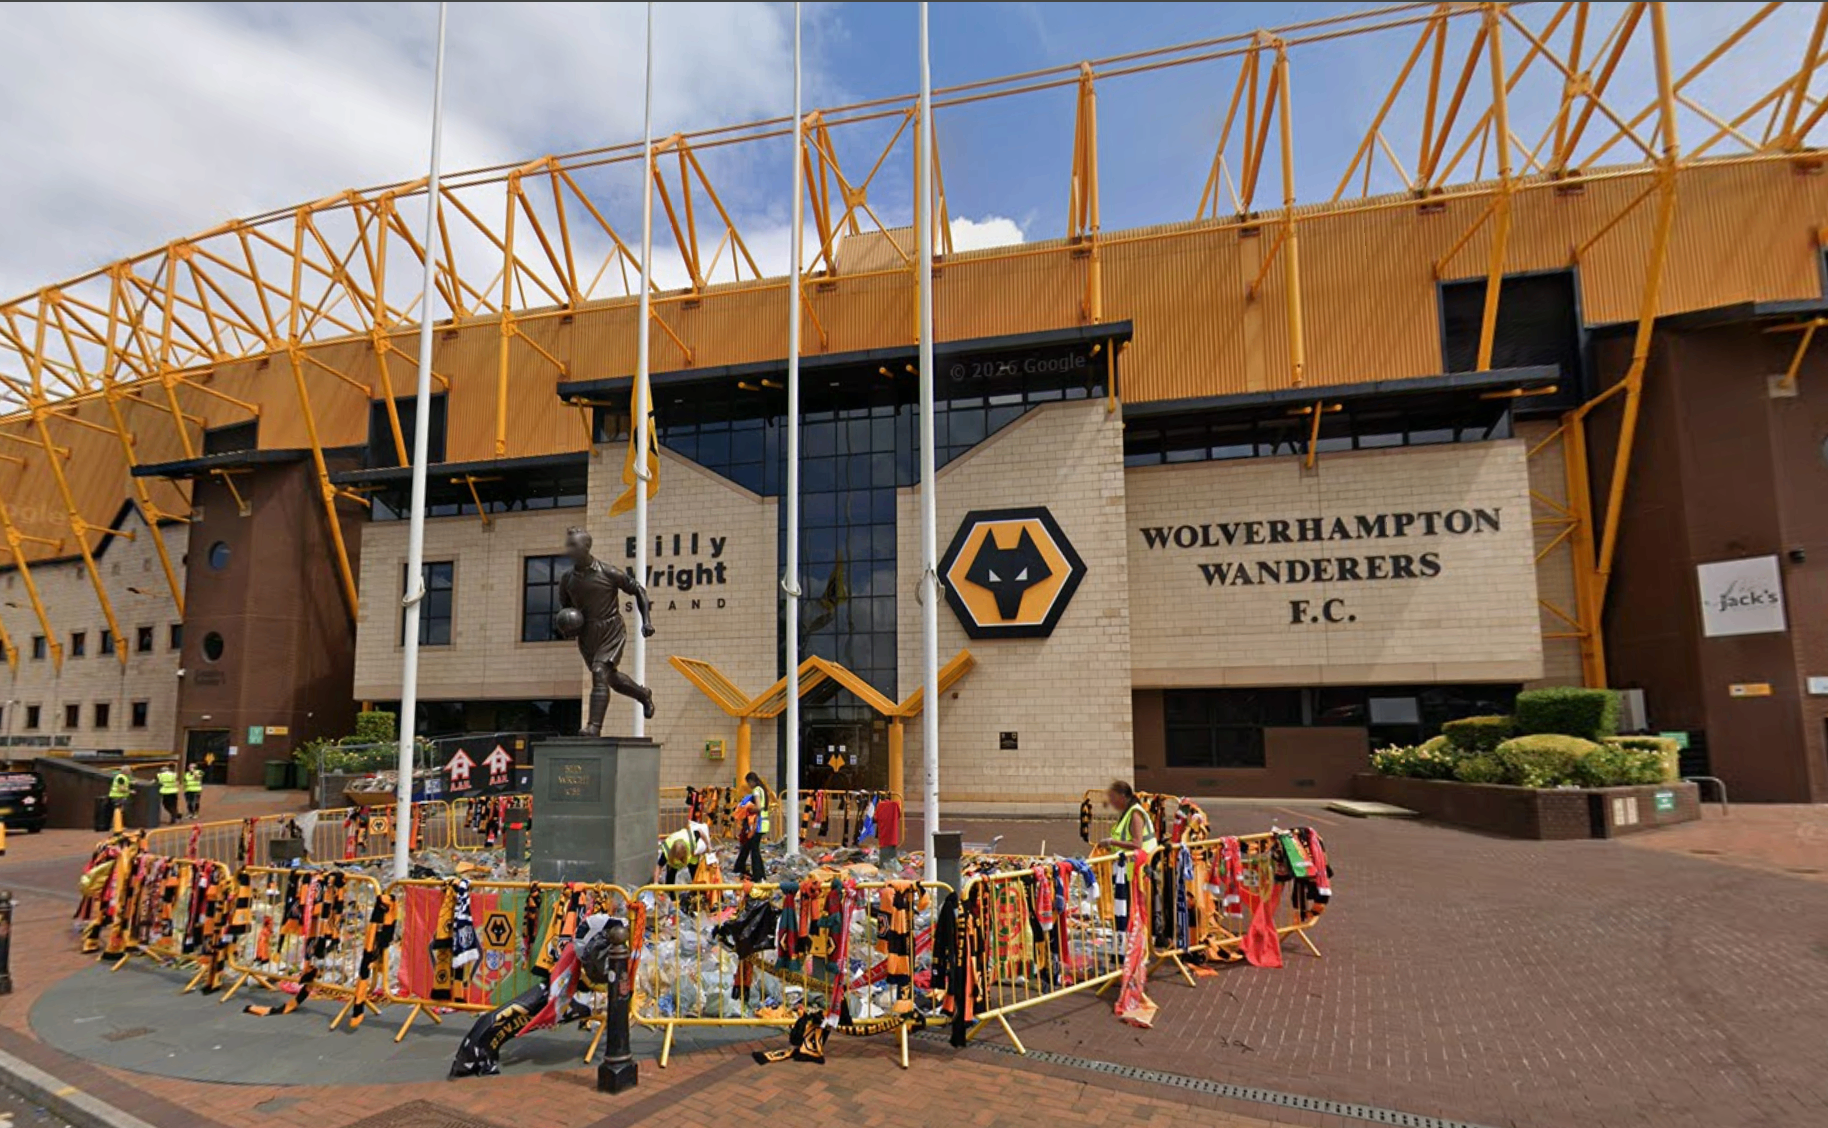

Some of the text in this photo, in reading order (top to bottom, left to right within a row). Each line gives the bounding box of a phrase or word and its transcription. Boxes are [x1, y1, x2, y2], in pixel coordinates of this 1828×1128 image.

[1140, 507, 1502, 549] WOLVERHAMPTON
[1198, 552, 1442, 586] WANDERERS
[1288, 598, 1357, 624] F.C.
[1718, 589, 1779, 613] jack's
